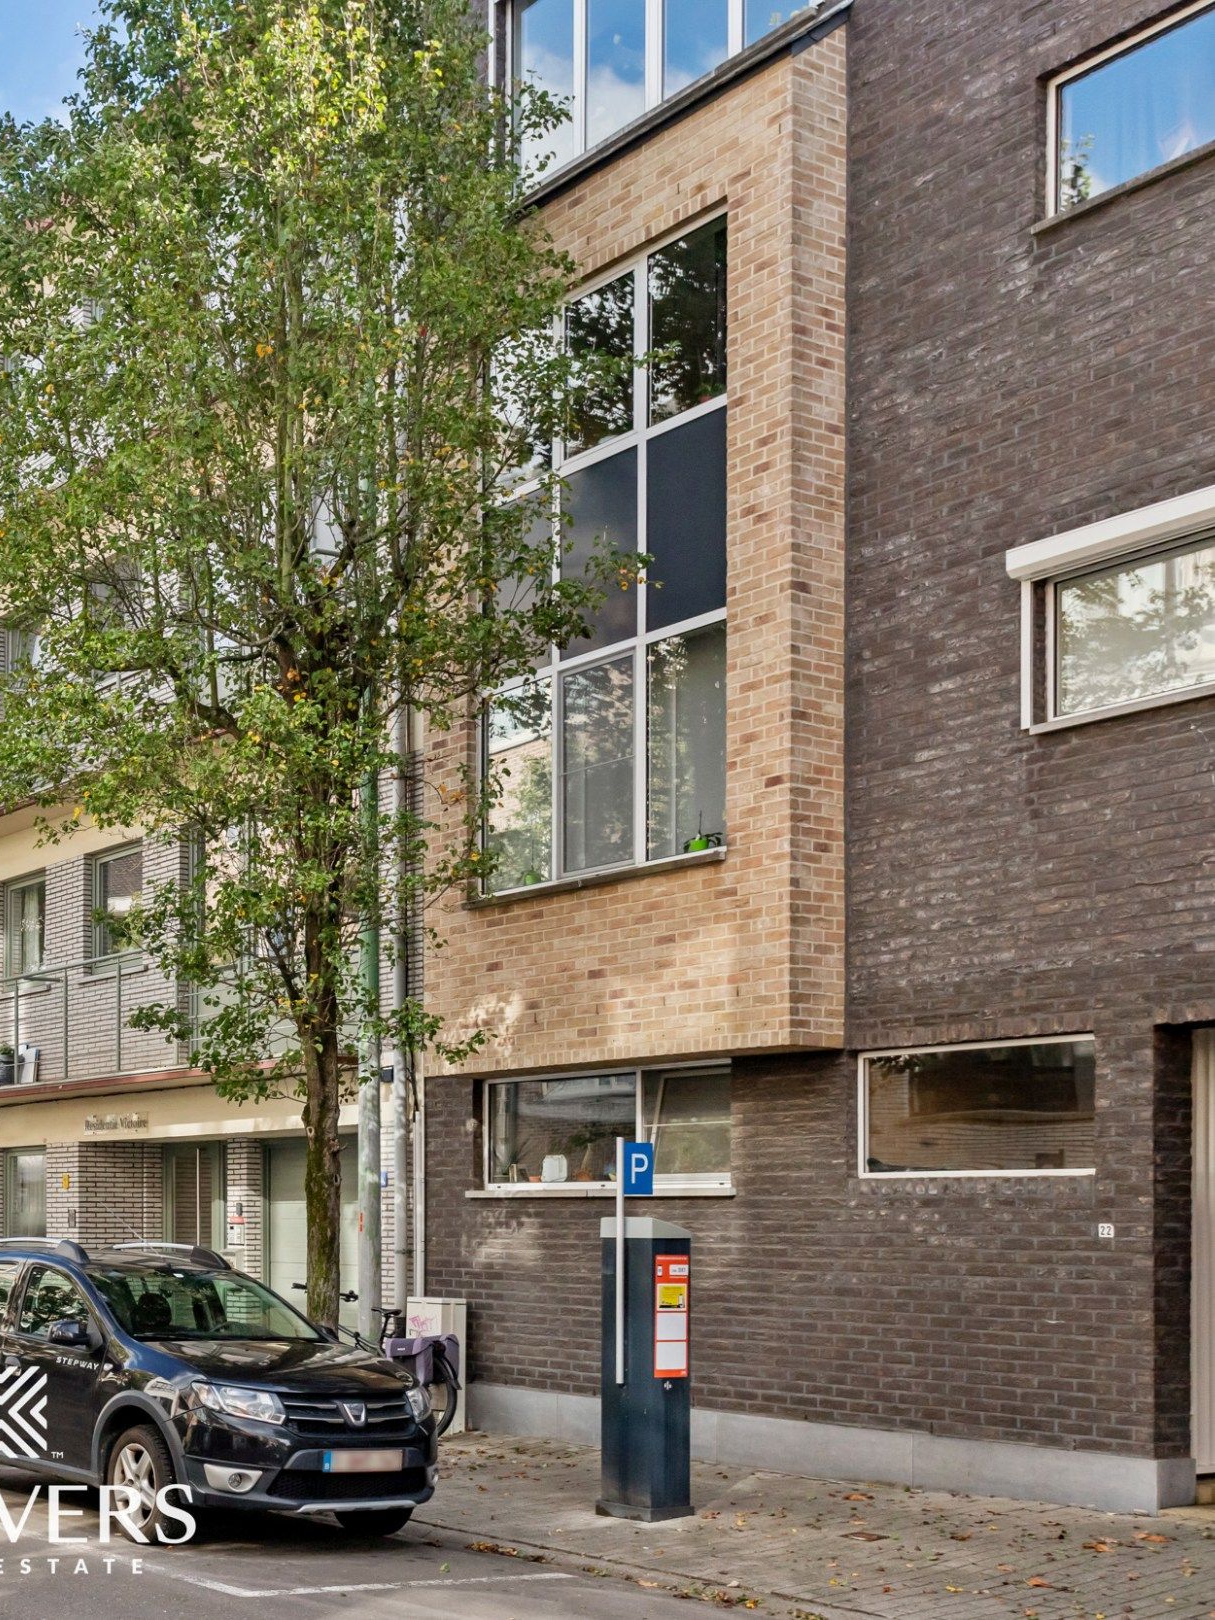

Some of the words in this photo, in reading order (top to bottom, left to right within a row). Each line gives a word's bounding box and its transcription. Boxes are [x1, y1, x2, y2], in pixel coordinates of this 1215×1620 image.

[630, 1153, 649, 1184] P
[1100, 1225, 1112, 1236] 22
[56, 1356, 99, 1370] STEPWAY
